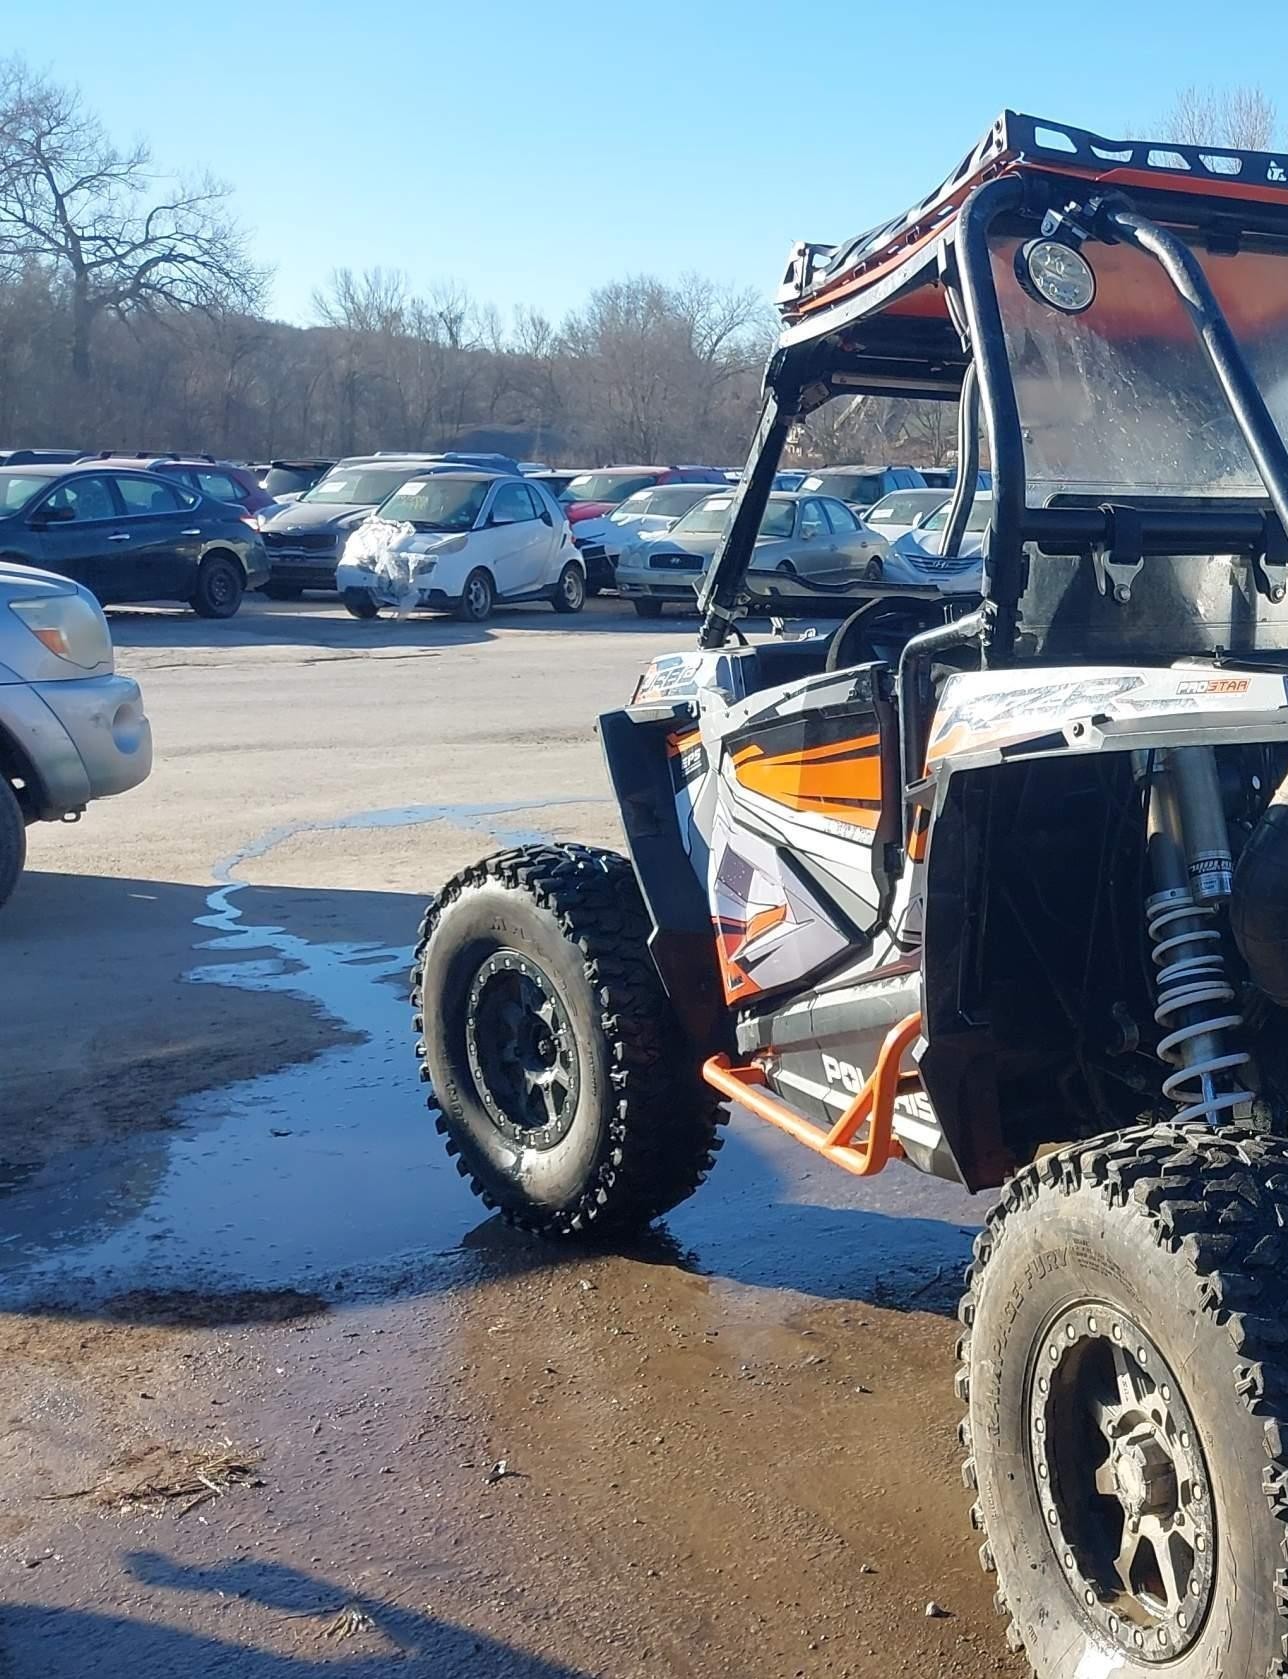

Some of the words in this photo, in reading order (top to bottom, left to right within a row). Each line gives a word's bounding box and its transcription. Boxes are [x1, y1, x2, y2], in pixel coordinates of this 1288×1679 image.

[1176, 679, 1249, 695] PROSTAR
[681, 747, 702, 770] EPS
[1024, 1246, 1069, 1291] FURY
